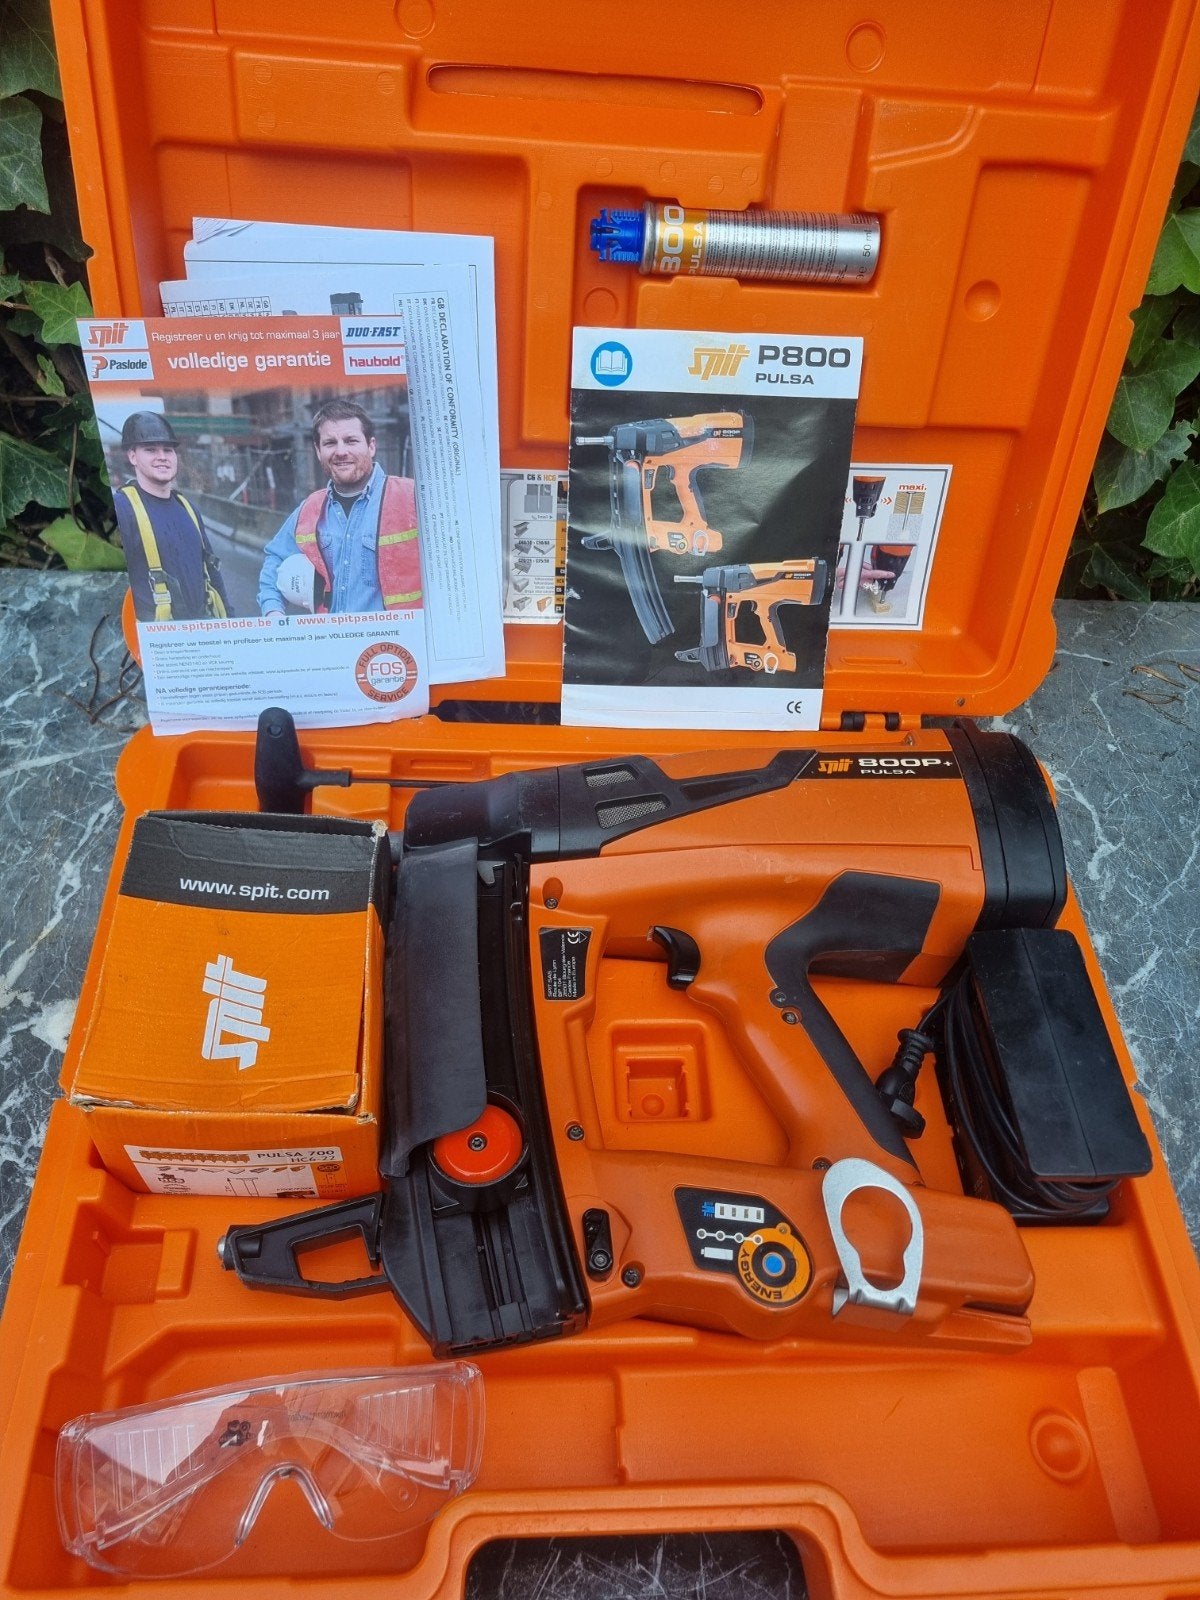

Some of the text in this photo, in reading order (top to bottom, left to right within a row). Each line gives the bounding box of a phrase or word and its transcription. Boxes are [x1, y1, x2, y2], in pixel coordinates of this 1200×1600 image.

[660, 205, 685, 274] 800
[688, 221, 706, 275] PULSA
[863, 245, 873, 258] 50
[437, 297, 446, 310] GB
[152, 330, 341, 344] Registreer u en krijg tot maximaal 3 jaar
[346, 326, 401, 338] DUO-FAST
[438, 312, 451, 371] DECLARATION
[110, 358, 148, 370] Paslode
[167, 350, 332, 372] volledige garantie
[687, 343, 851, 381] spit P800
[444, 374, 453, 384] OF
[755, 373, 815, 385] PULSA
[446, 386, 459, 439] CONFORMITY
[146, 611, 414, 633] www.spitpaslode.be of www.spitpaslode.nl
[366, 630, 400, 638] GARANTIE
[359, 644, 413, 668] FULL OPTION
[370, 661, 403, 676] FOS
[370, 675, 405, 686] garantie
[367, 686, 409, 703] SERVICE
[818, 759, 854, 774] spit
[179, 876, 330, 902] www.spit.com
[740, 1248, 783, 1300] ENERGY
